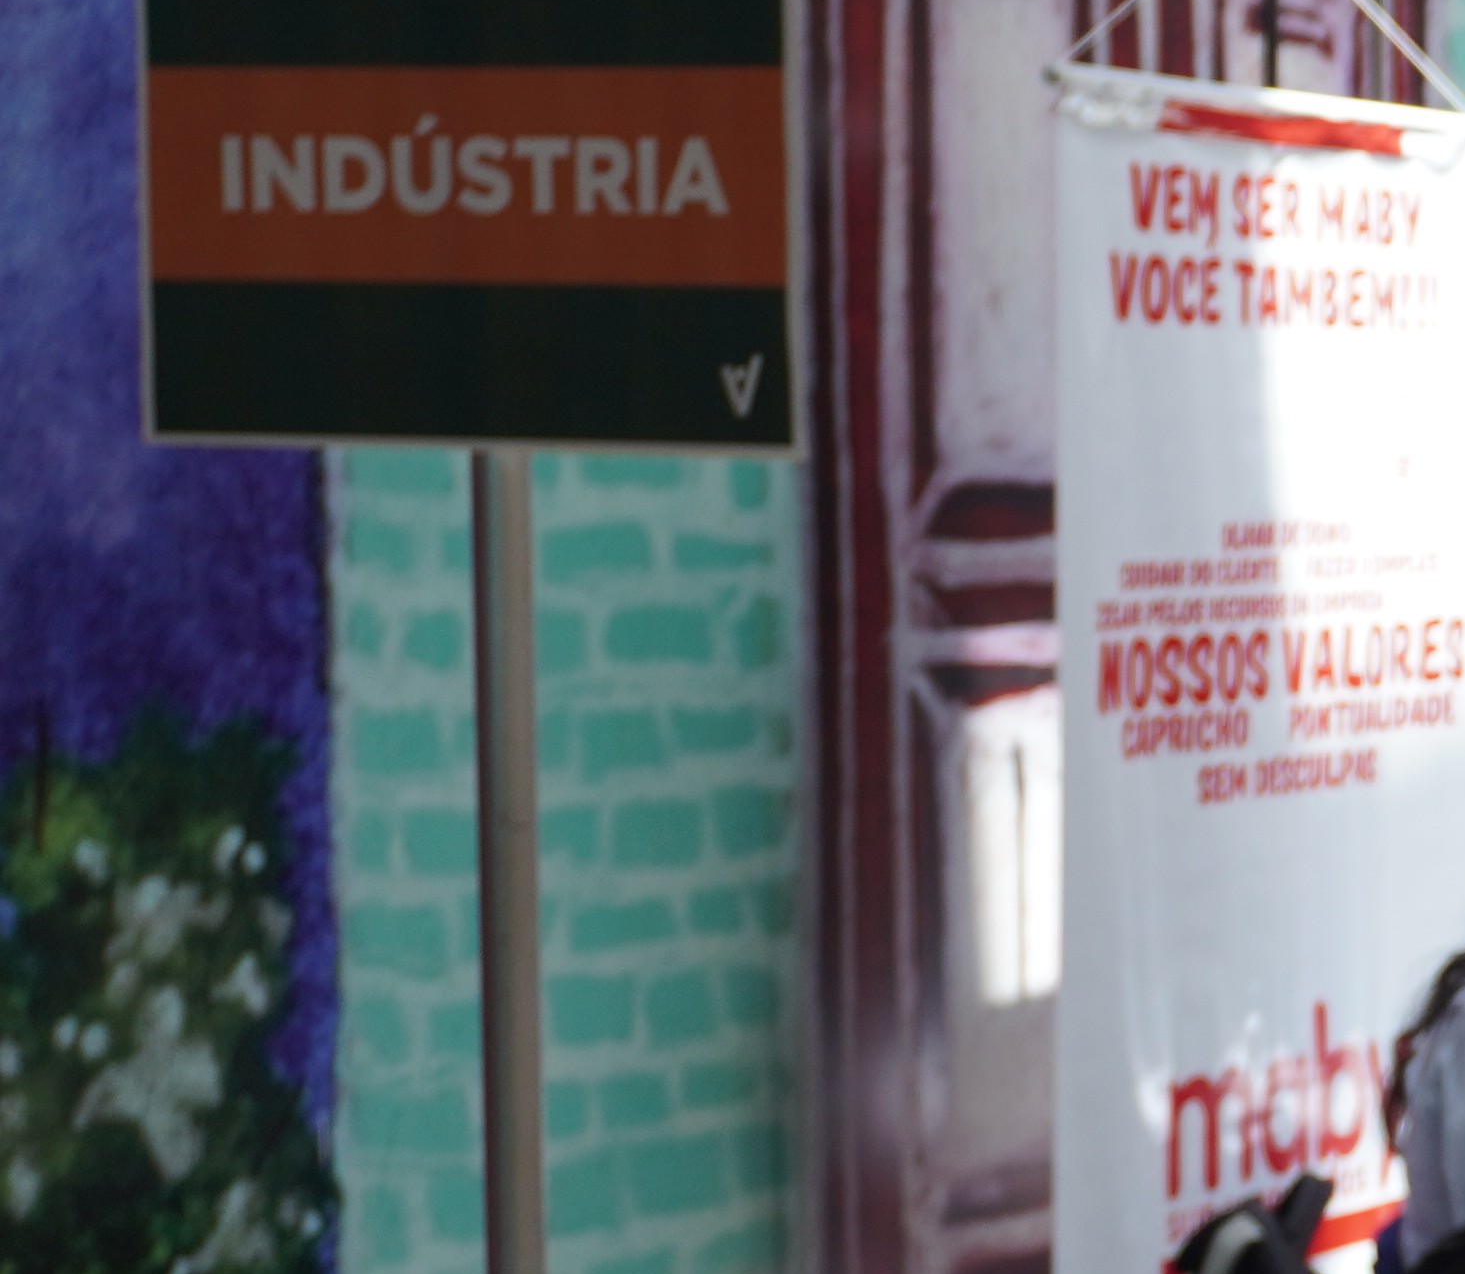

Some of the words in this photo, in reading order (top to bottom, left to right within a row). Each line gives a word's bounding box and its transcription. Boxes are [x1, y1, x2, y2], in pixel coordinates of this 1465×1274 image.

[219, 113, 730, 217] INDÚSTRIA
[1129, 161, 1221, 235] VEM
[1232, 172, 1302, 240] SER
[1317, 183, 1423, 246] MABY
[1098, 629, 1271, 716] NOSSOS
[1281, 617, 1465, 695] VALORES
[1122, 709, 1251, 760] CAPRICHO
[1288, 692, 1456, 739] PONTUALIDADE
[1197, 762, 1248, 806] SEM
[1255, 747, 1379, 798] DESCULPAS
